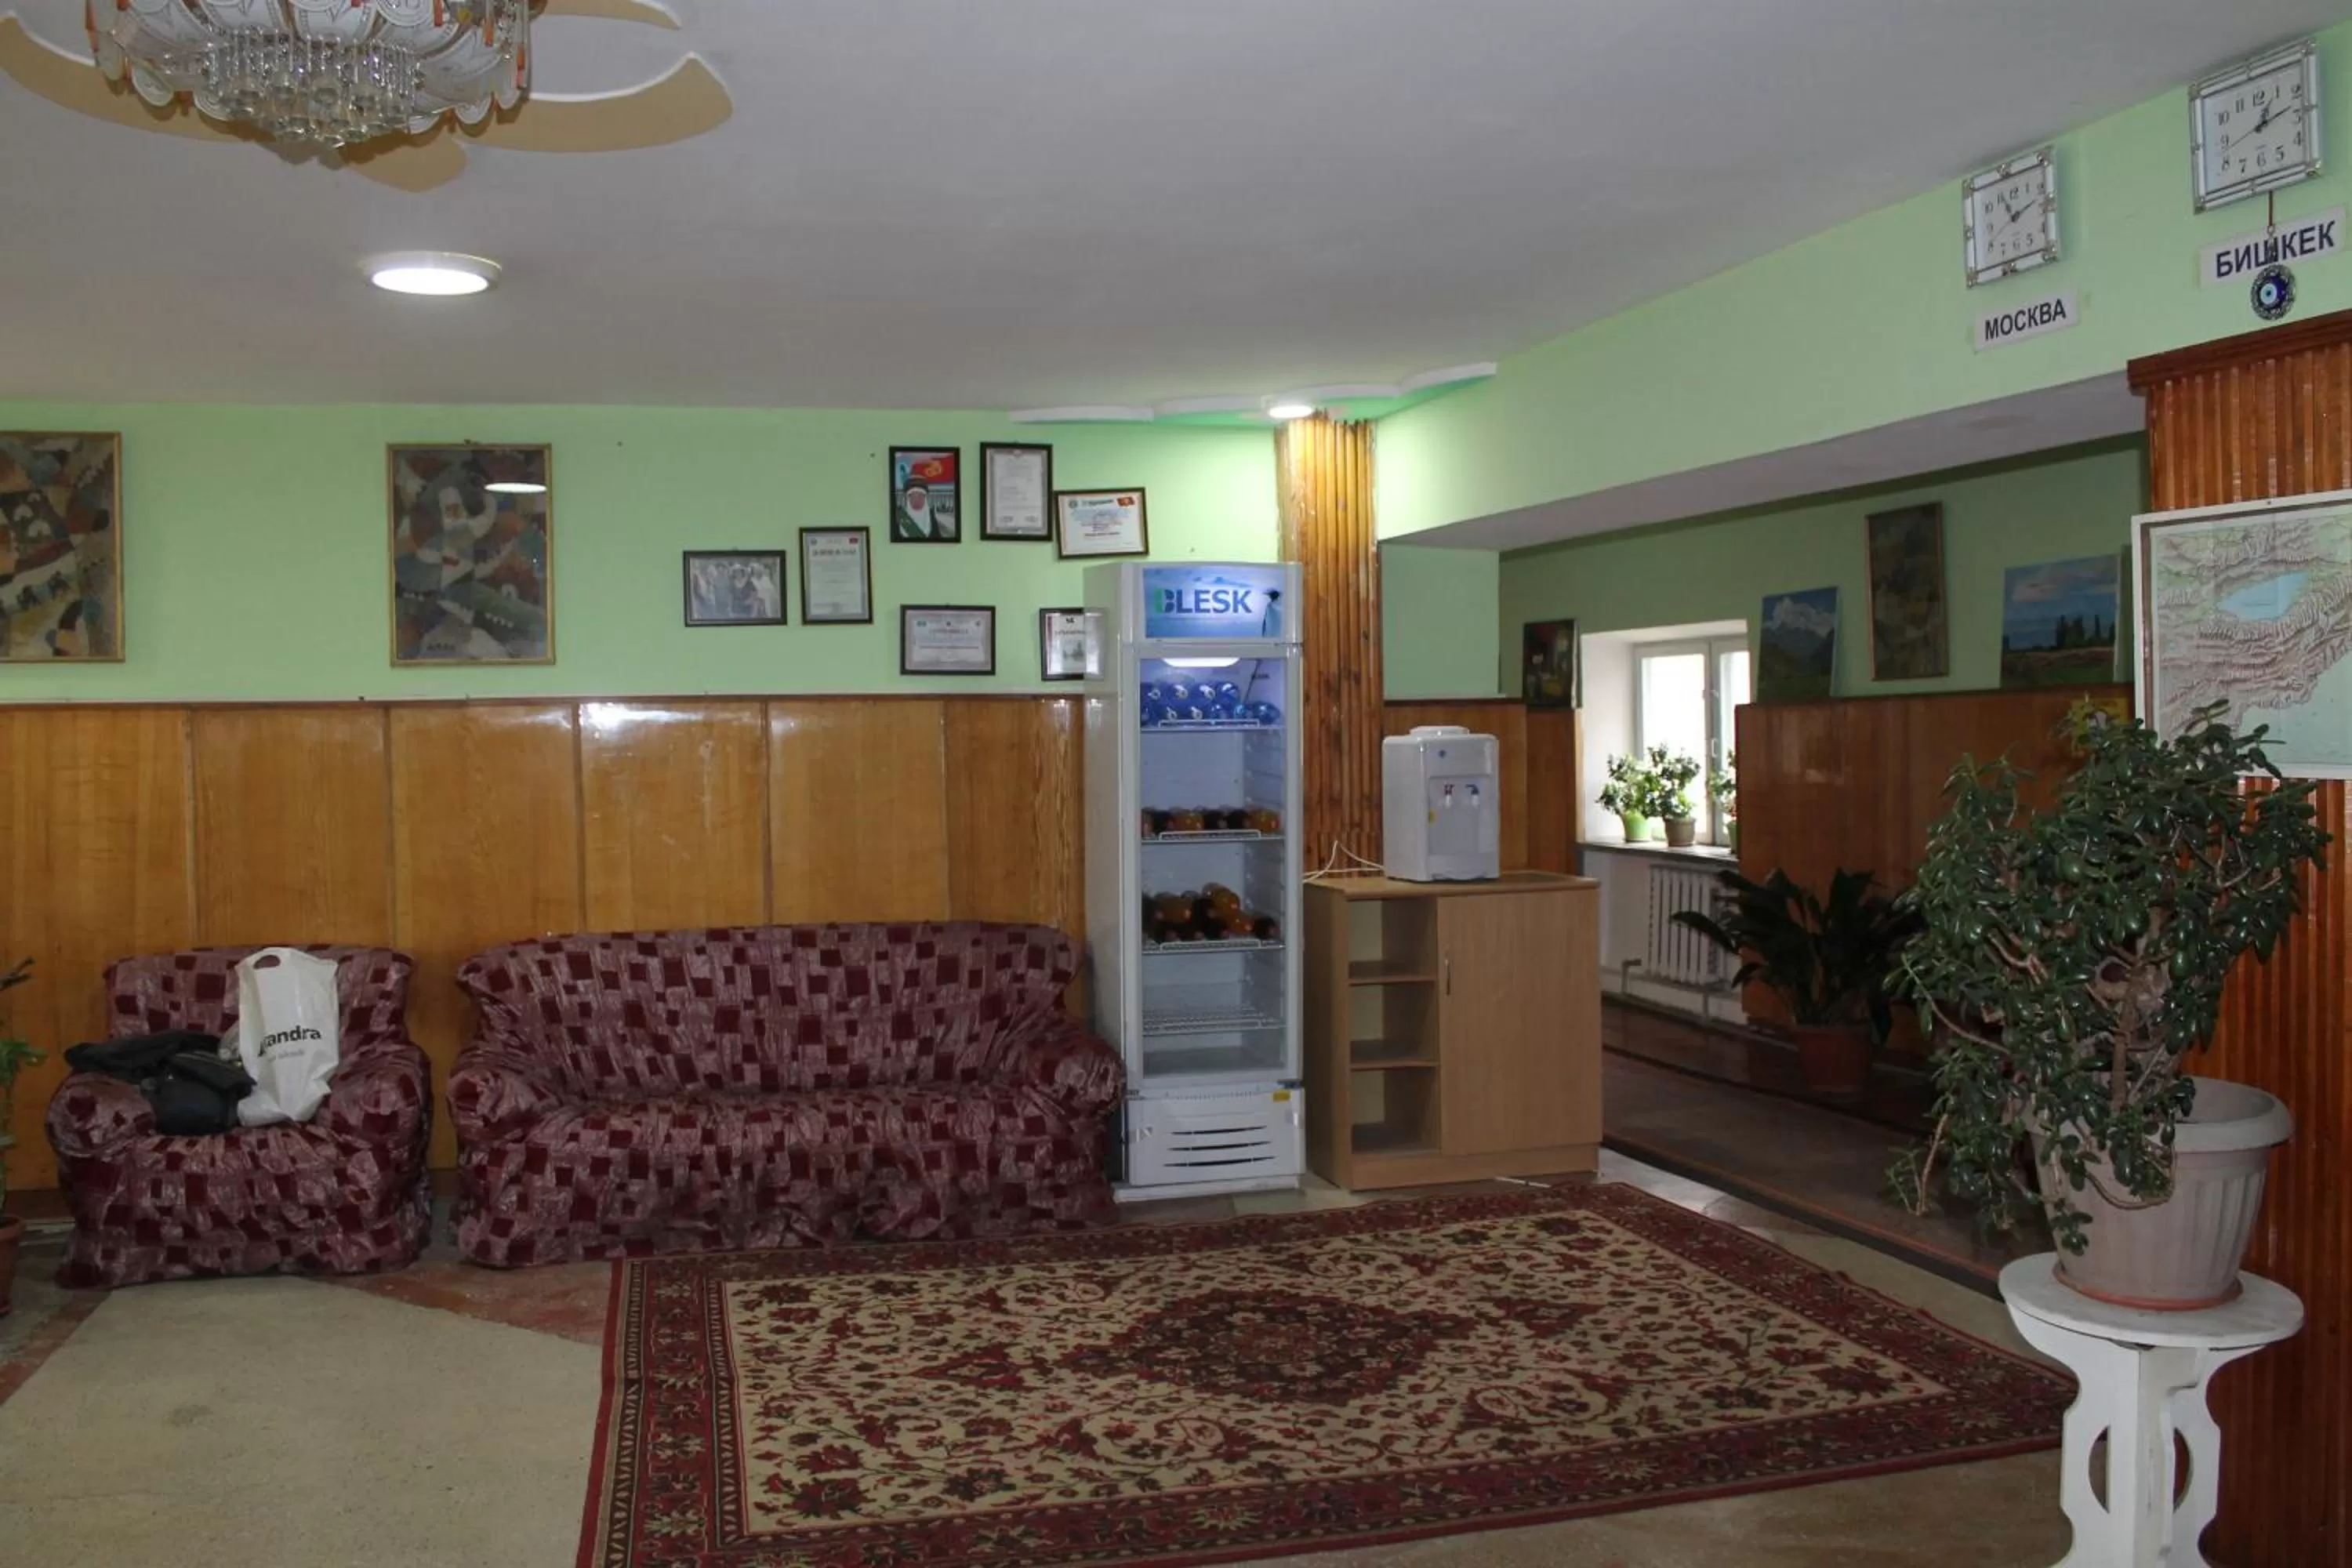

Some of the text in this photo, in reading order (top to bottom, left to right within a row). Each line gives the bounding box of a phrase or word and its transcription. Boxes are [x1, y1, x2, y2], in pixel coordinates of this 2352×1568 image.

[2235, 98, 2245, 114] 11
[2252, 90, 2265, 107] 12
[2218, 110, 2230, 126] 10
[2220, 135, 2229, 151] 9
[2293, 130, 2302, 147] 4
[2256, 151, 2267, 168] 6
[2275, 144, 2285, 162] 5
[2222, 156, 2230, 172] 8
[2238, 158, 2248, 174] 7
[2009, 187, 2019, 201] 12
[2026, 233, 2034, 246] 5
[2216, 220, 2336, 278] БИШКЕК
[1985, 298, 2067, 341] МОСКВА
[1153, 589, 1253, 613] BLESK
